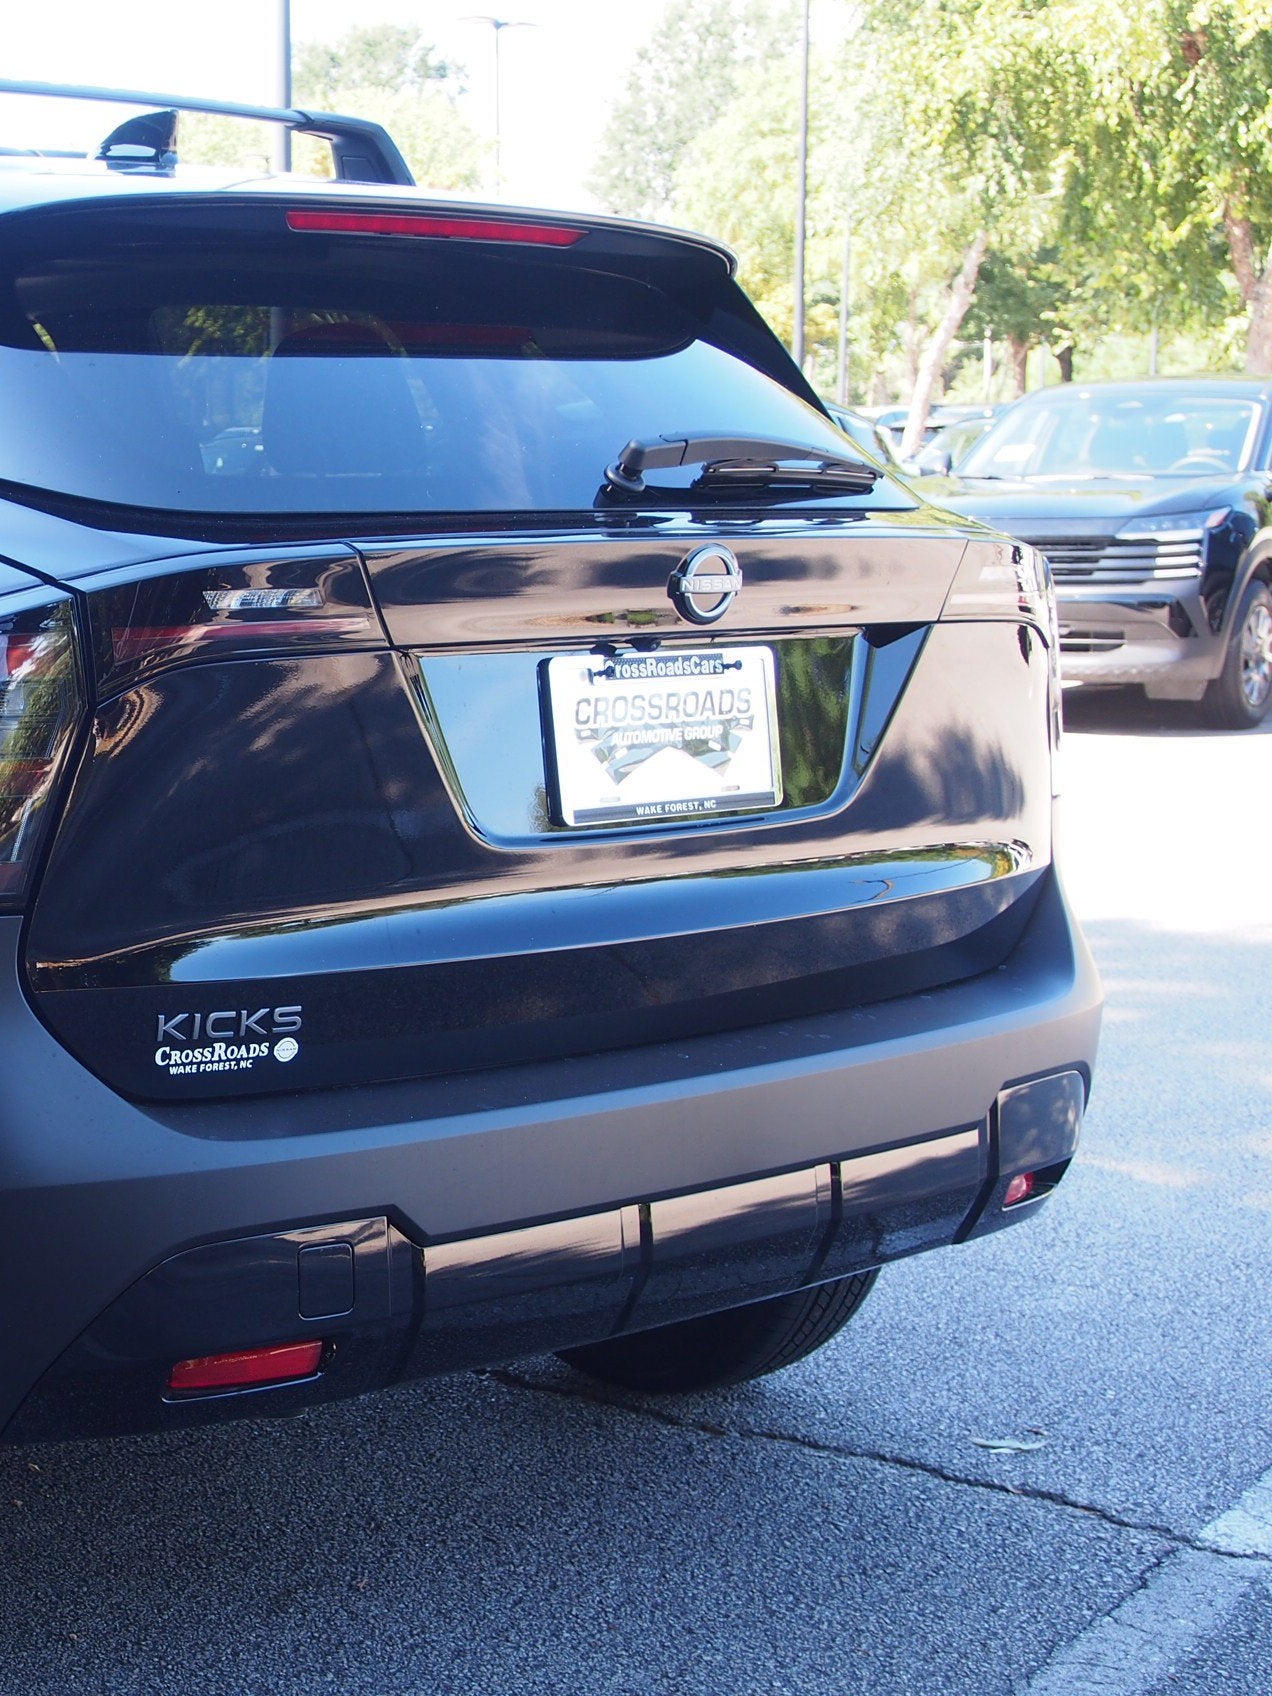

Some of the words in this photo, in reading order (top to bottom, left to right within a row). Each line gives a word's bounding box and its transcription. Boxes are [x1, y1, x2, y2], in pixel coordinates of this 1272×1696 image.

[681, 577, 740, 592] NISSAN
[575, 688, 752, 725] CROSSROADS
[612, 729, 682, 745] AUTOMOTIVE
[684, 725, 723, 741] GROUP
[636, 805, 662, 815] WAKE
[665, 802, 702, 814] FOREST,
[703, 800, 717, 810] NC
[156, 1005, 302, 1042] KICKS
[169, 1064, 197, 1075] WAKE
[200, 1061, 238, 1073] FOREST,
[239, 1059, 253, 1069] NC
